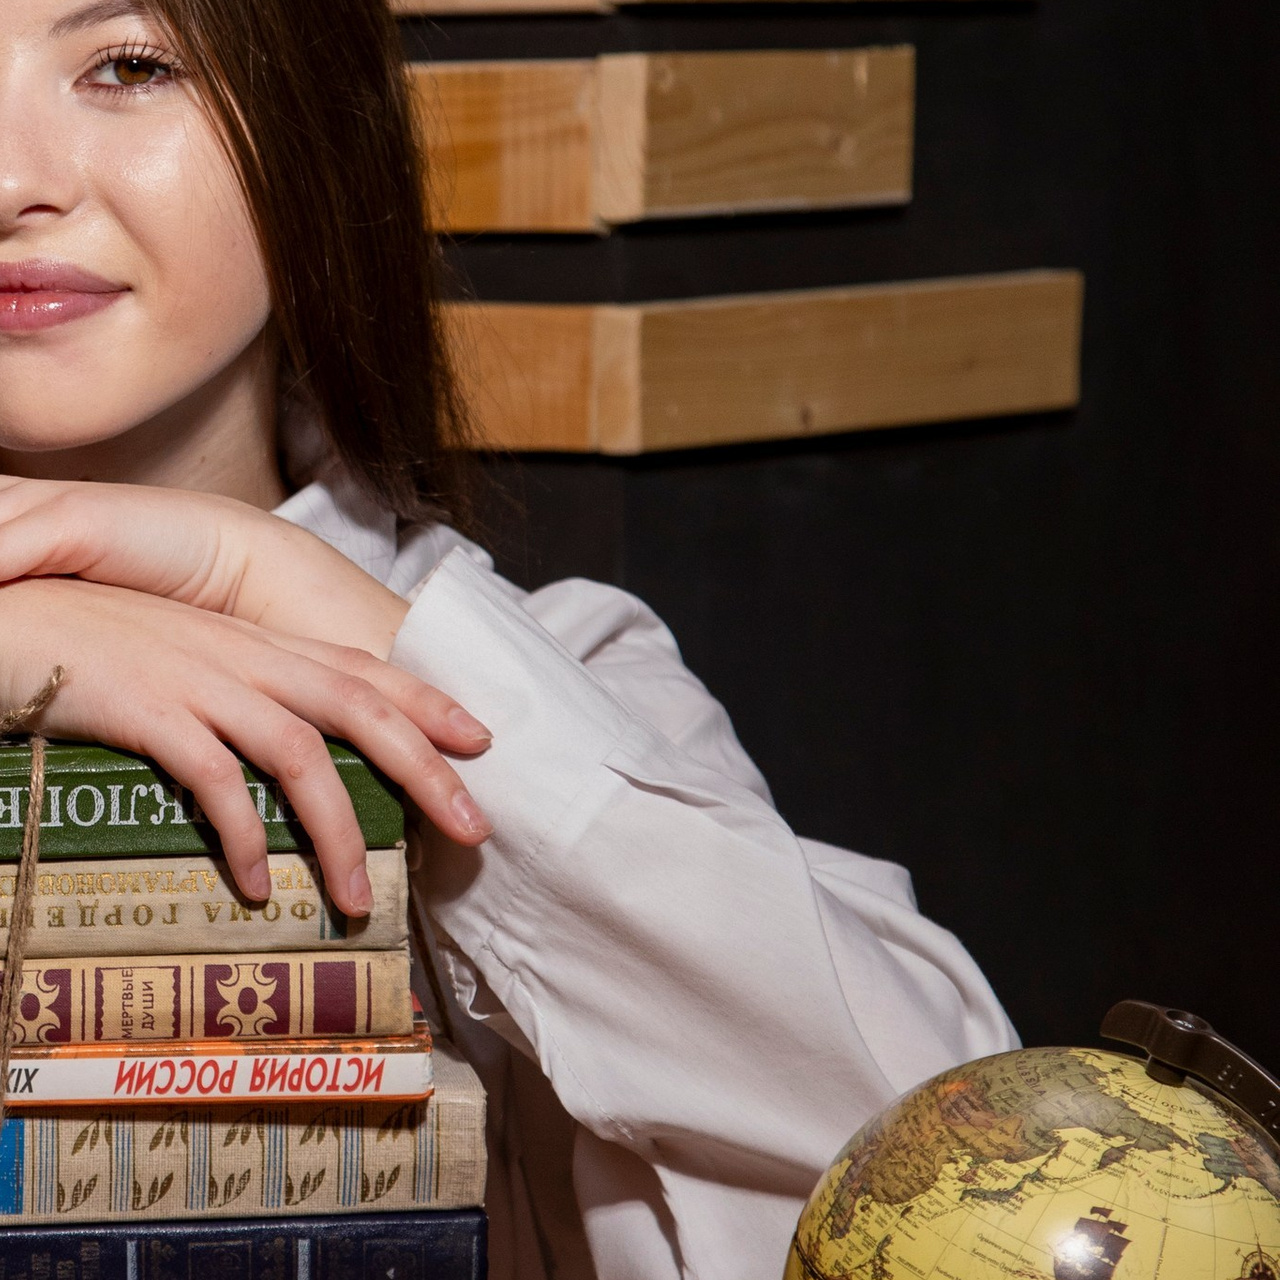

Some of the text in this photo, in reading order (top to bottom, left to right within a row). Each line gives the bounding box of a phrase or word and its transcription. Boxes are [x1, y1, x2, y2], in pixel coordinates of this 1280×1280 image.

[201, 899, 317, 924] ФОМА
[121, 968, 134, 1040] МЕРТВЫЕ
[141, 980, 155, 1031] ДУШИ
[112, 1057, 387, 1096] ИСТОРИЯ РОССИИ
[1161, 1100, 1201, 1116] OCEAN
